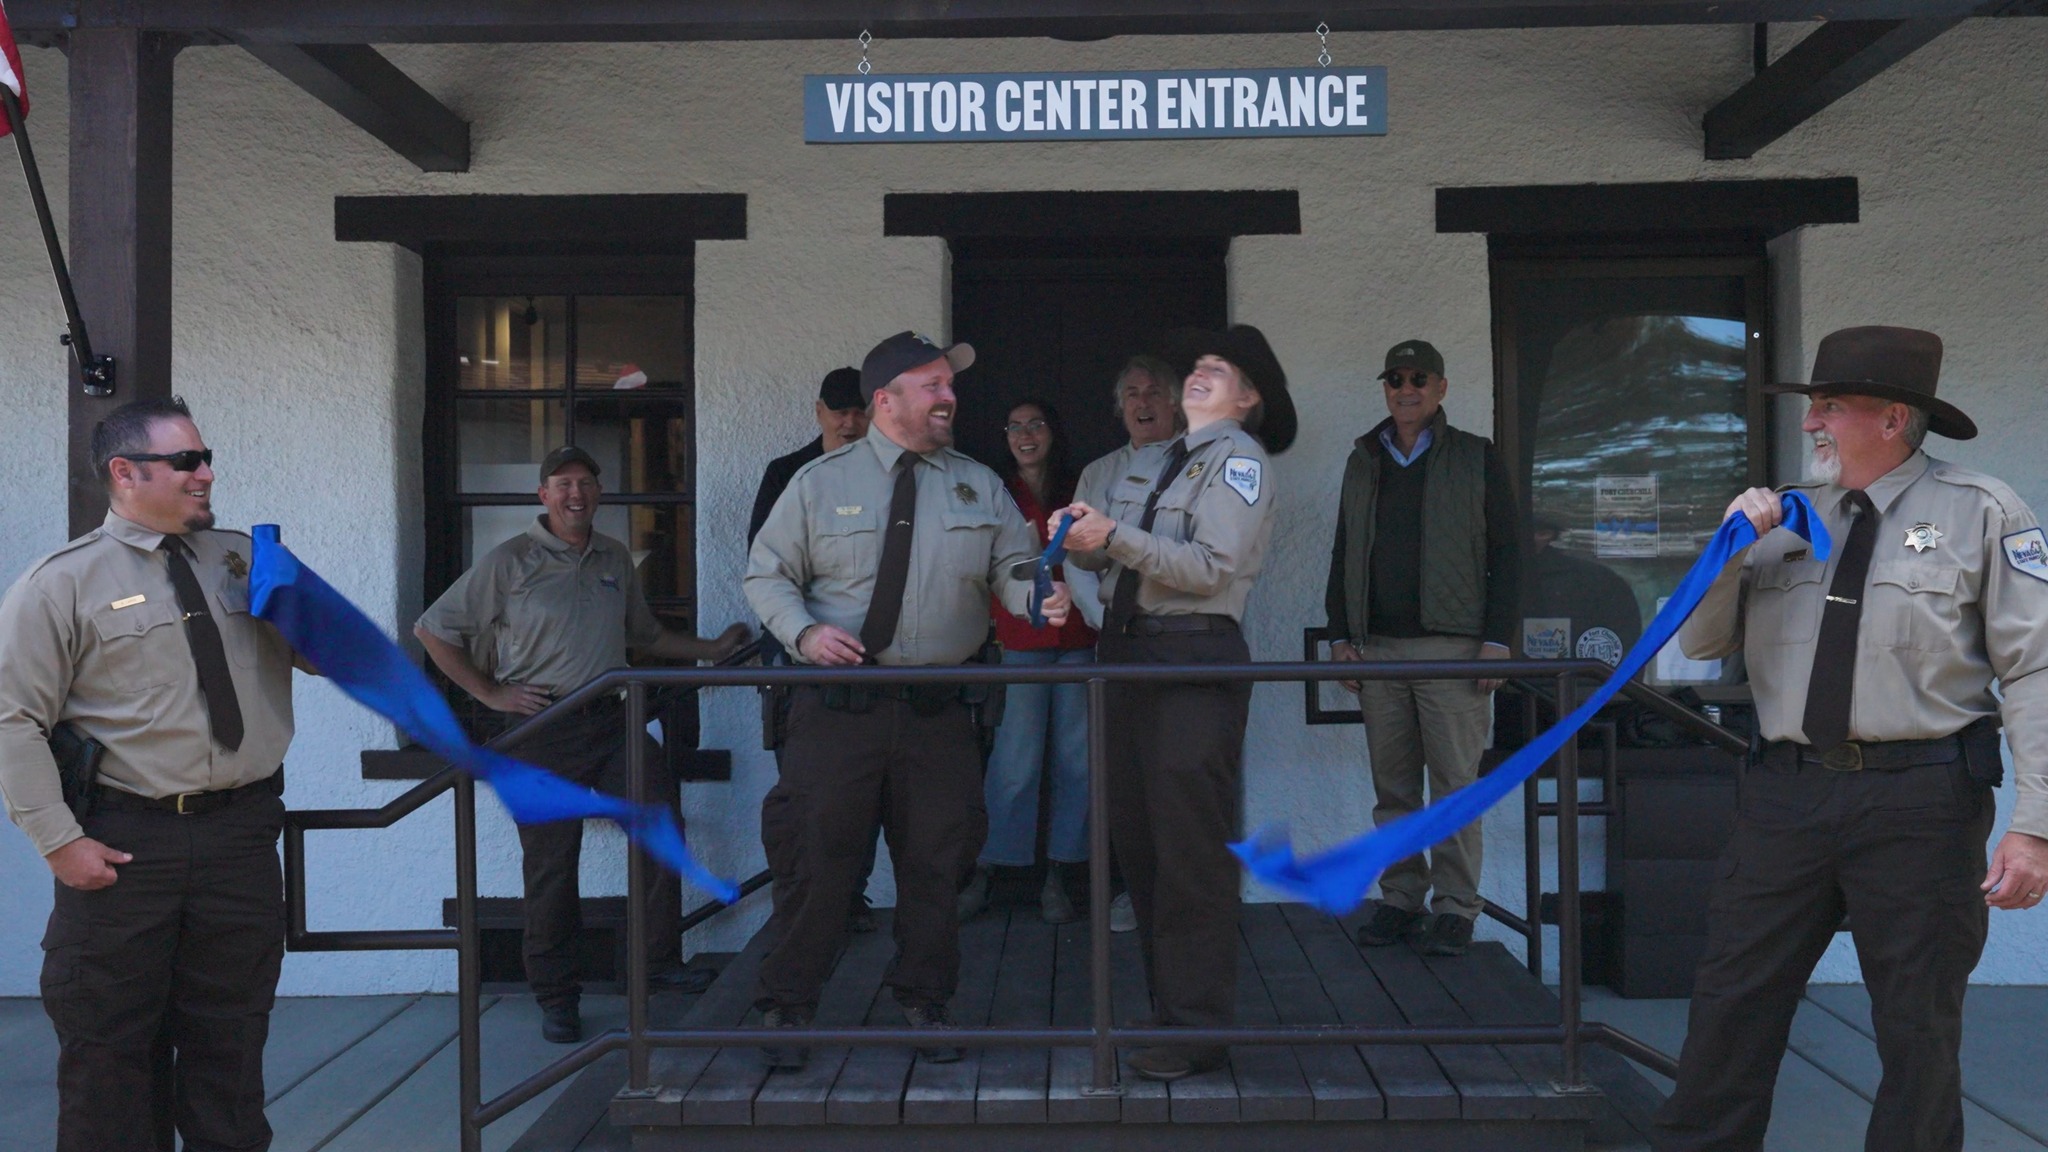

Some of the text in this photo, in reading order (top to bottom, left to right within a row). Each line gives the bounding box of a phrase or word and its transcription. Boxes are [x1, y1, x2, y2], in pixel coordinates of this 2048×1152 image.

[826, 75, 1368, 133] VISITOR CENTER ENTRANCE
